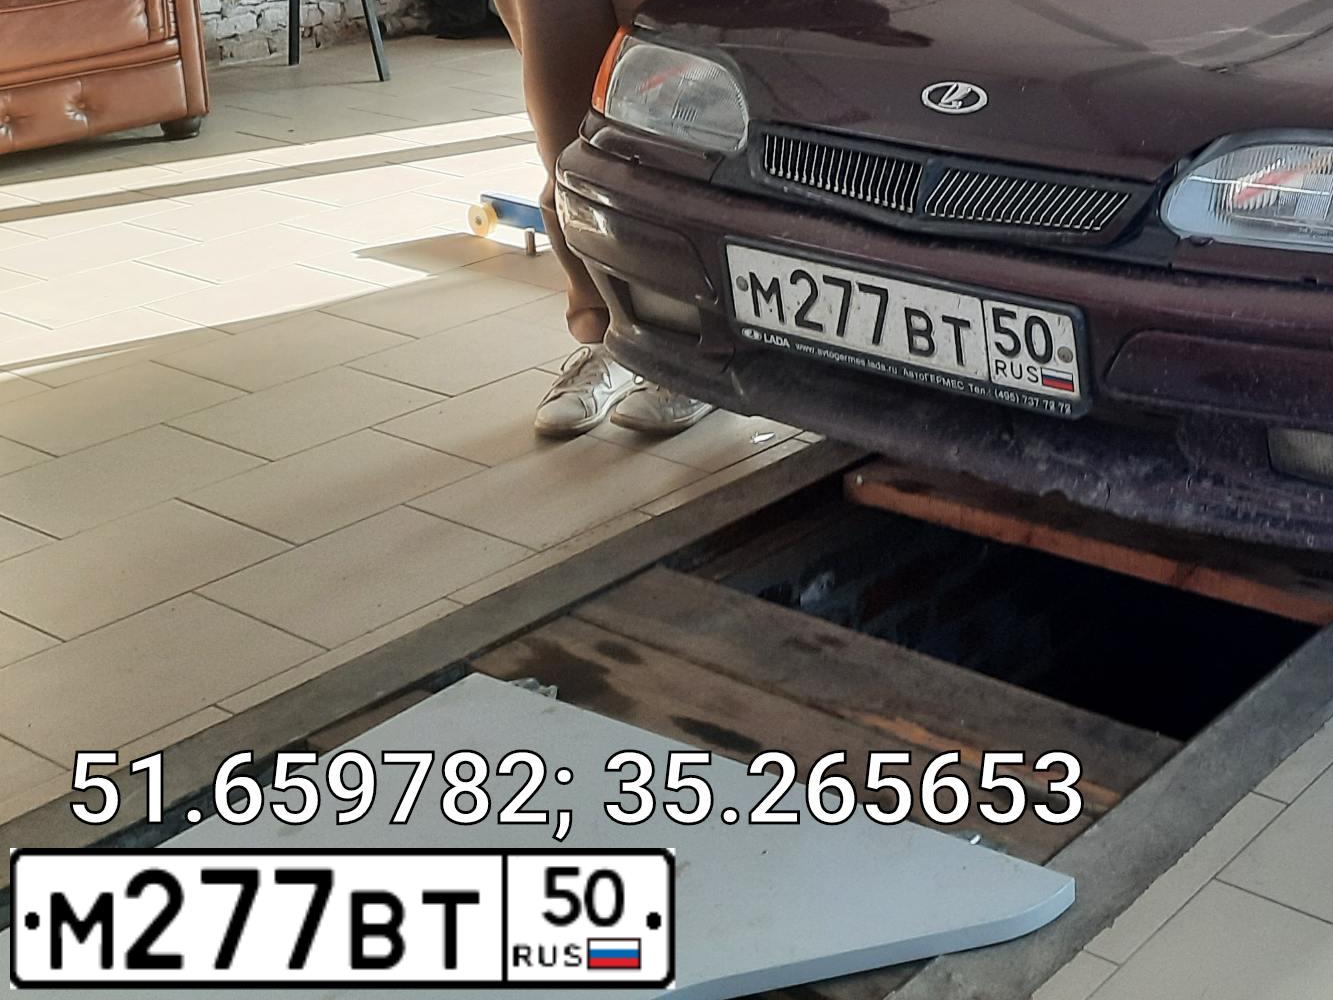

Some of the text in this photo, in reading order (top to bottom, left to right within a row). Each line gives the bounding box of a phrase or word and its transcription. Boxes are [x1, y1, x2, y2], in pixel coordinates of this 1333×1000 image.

[748, 269, 1054, 366] М277ВТ 50
[763, 333, 791, 348] LADA
[994, 359, 1040, 384] RUS
[994, 388, 1019, 404] (495)
[1022, 394, 1040, 408] 737
